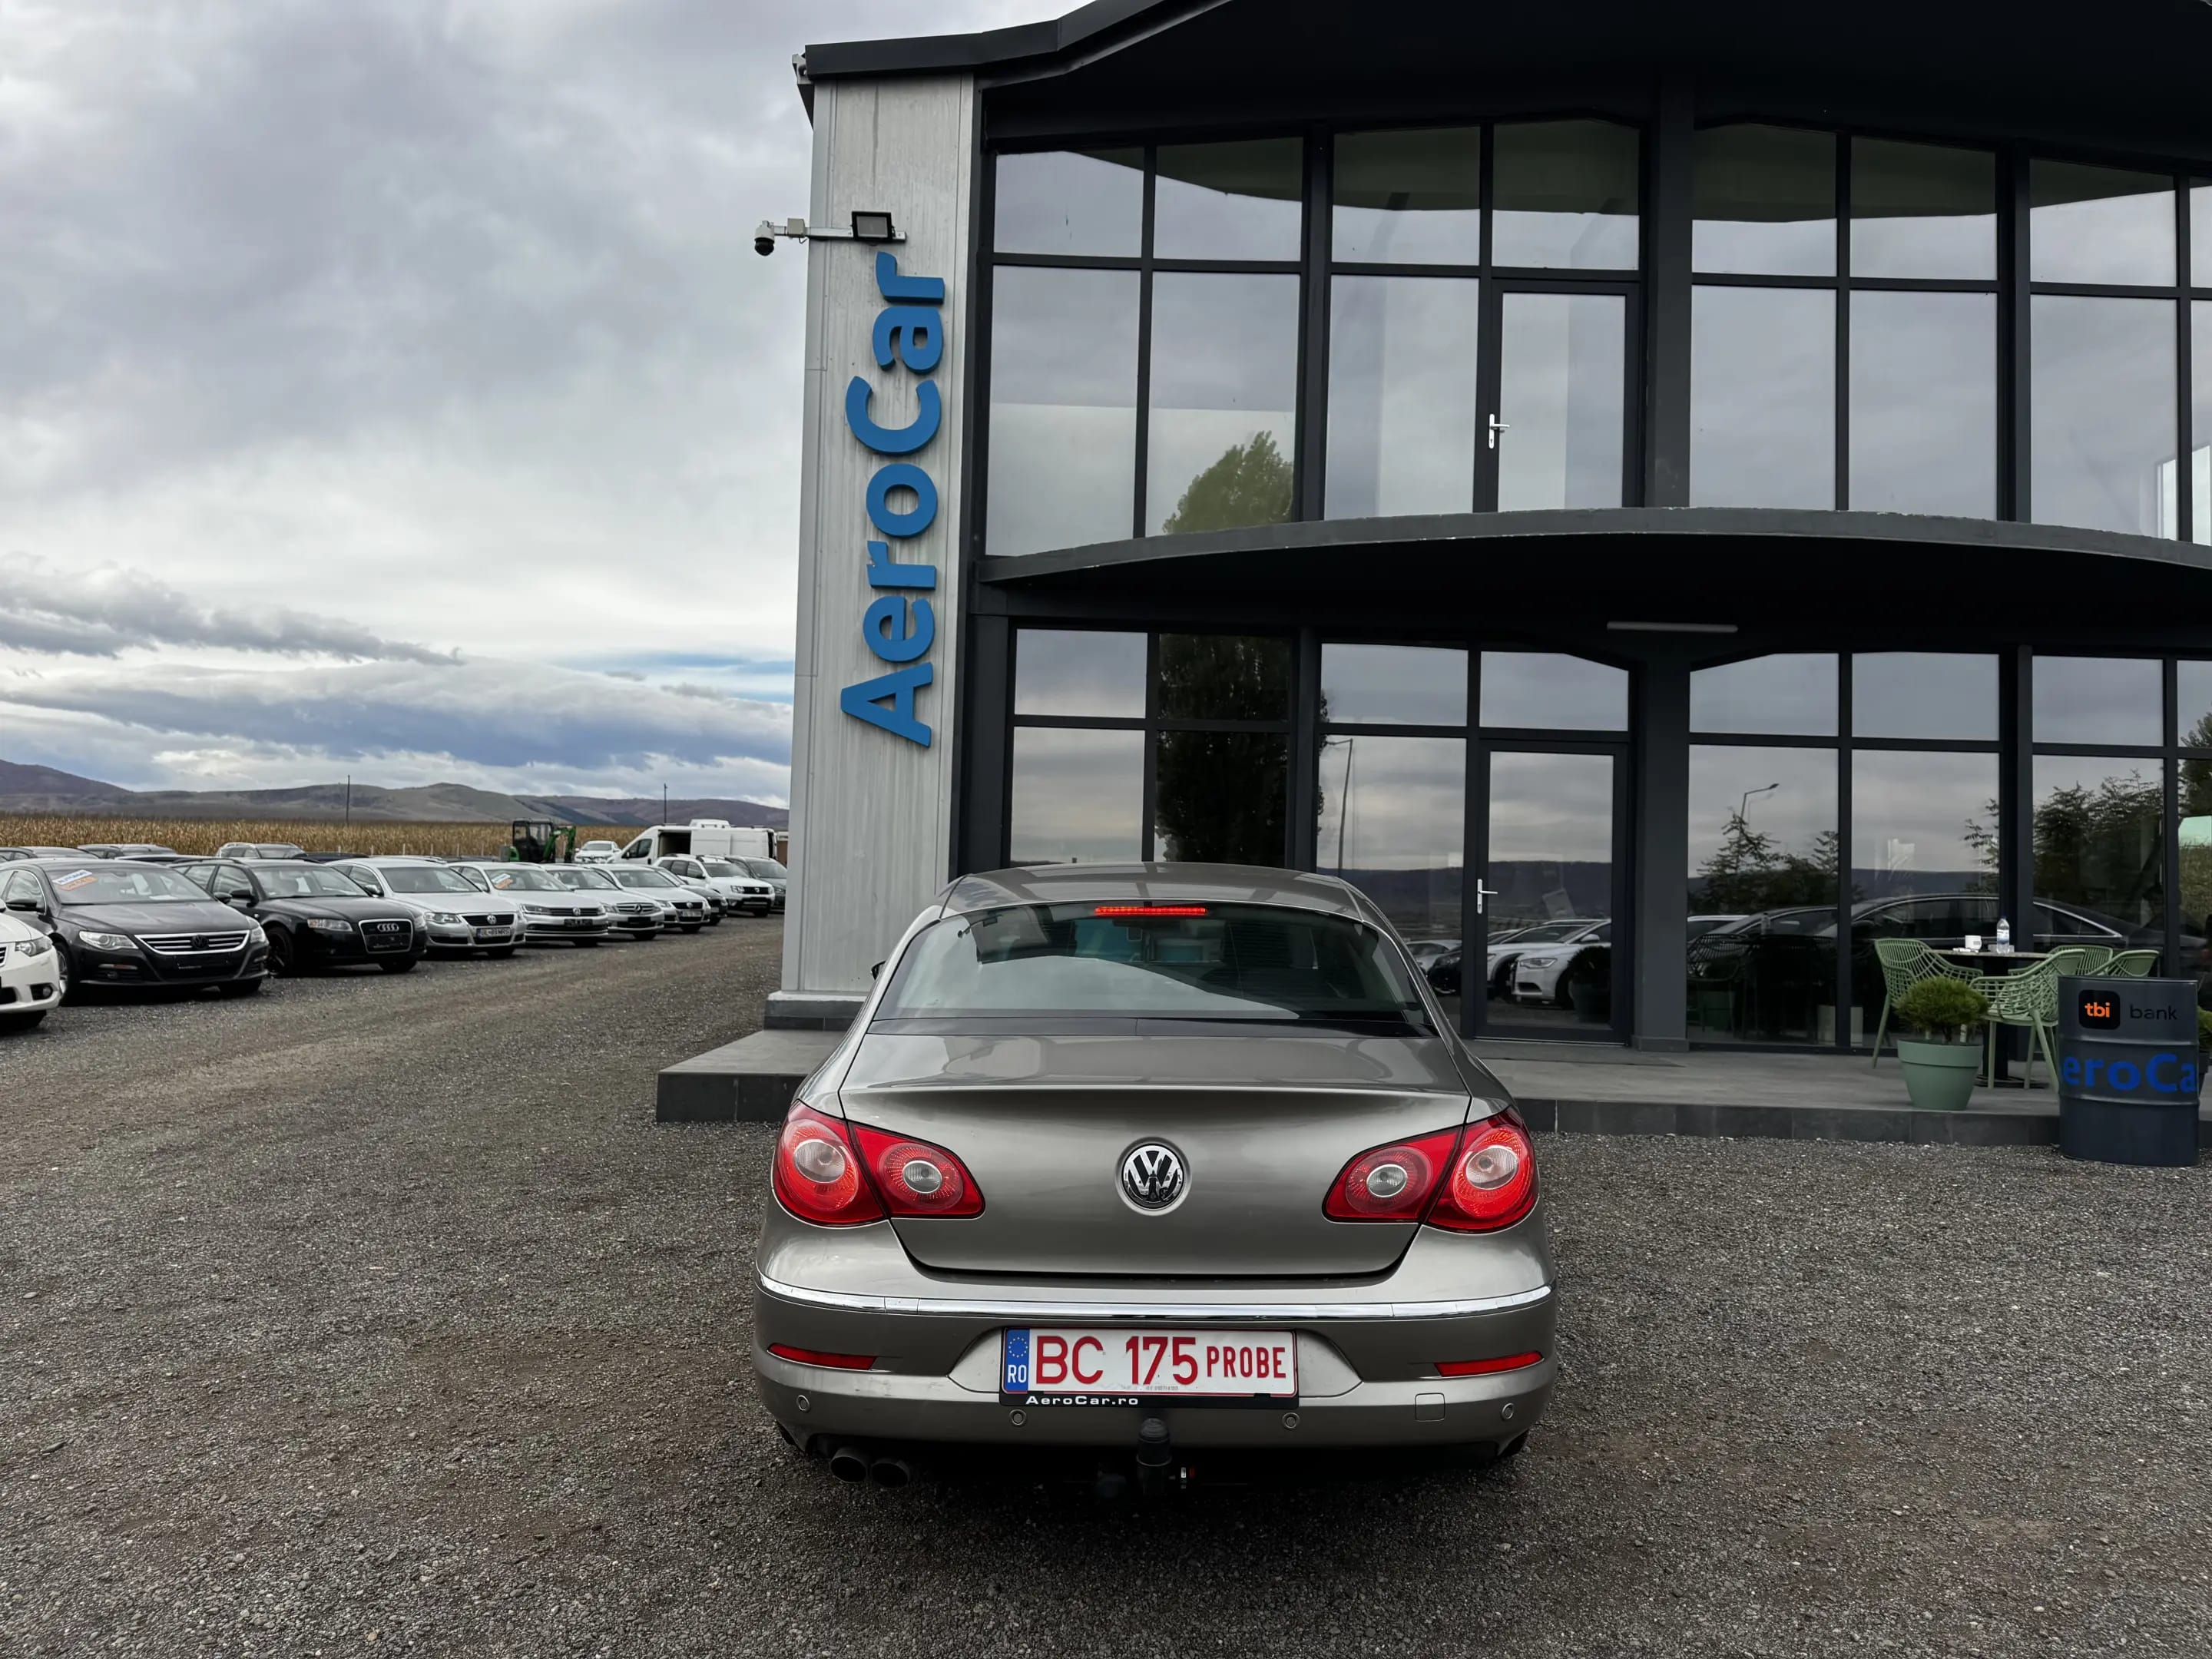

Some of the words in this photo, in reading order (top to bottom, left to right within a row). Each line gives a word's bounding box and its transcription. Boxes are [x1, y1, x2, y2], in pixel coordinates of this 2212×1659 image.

[840, 251, 945, 748] AeroCar
[2084, 1002, 2111, 1018] tbi
[2130, 1004, 2177, 1020] bank
[1008, 1364, 1027, 1383] RO
[1036, 1336, 1104, 1384] BC
[1126, 1336, 1198, 1385] 175
[1207, 1346, 1286, 1378] PROBE
[1025, 1395, 1138, 1406] AeroCar.ro
